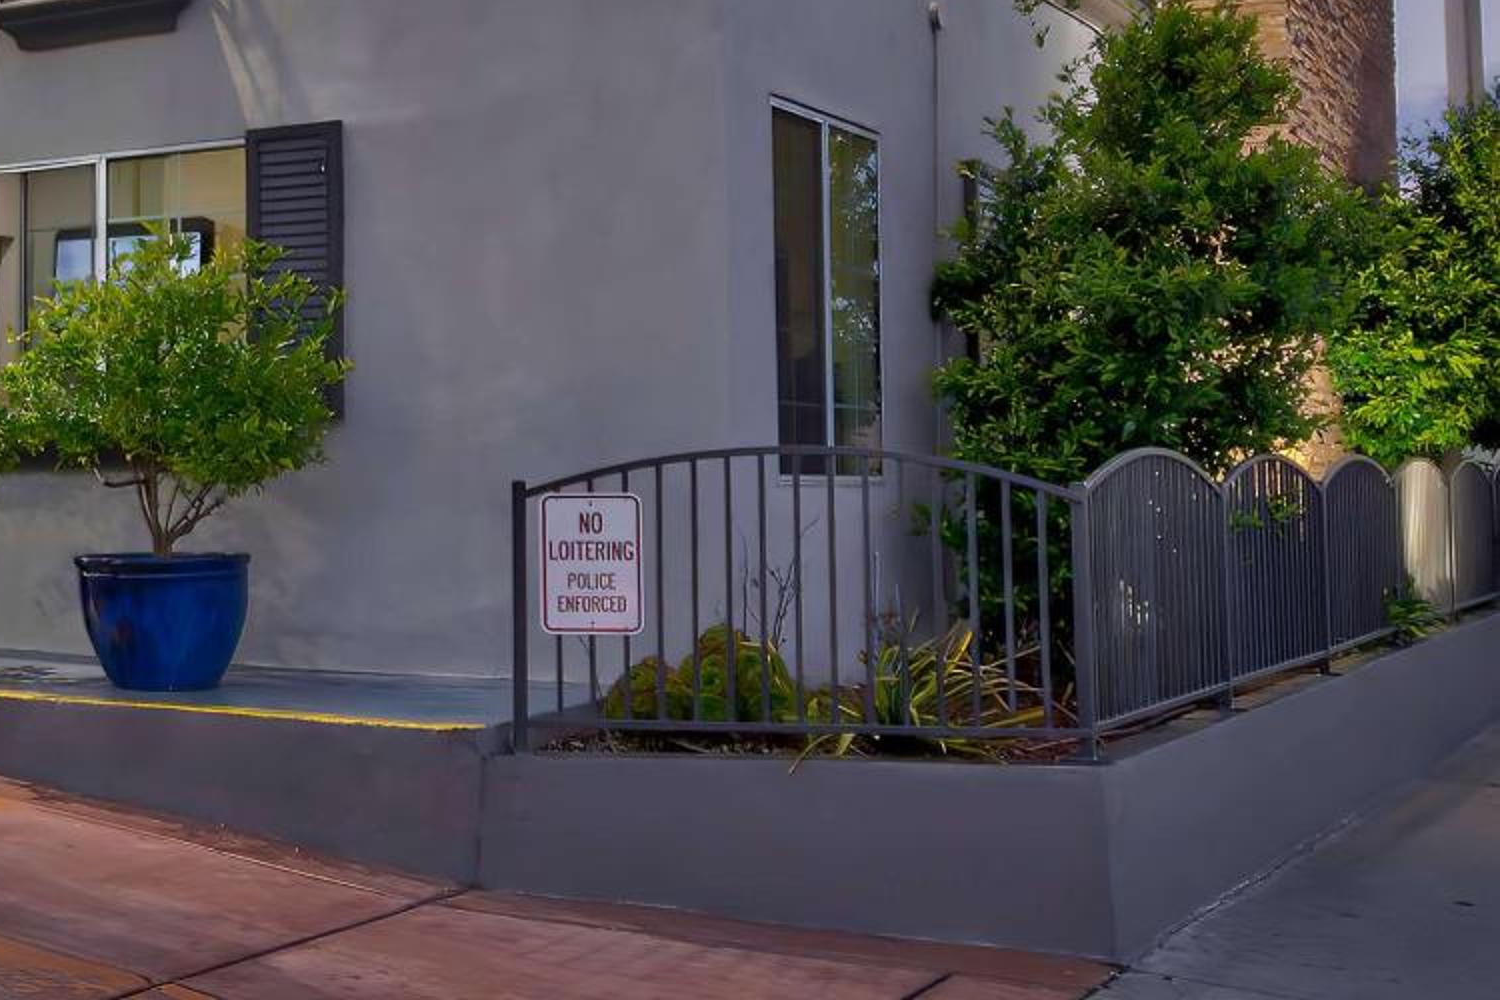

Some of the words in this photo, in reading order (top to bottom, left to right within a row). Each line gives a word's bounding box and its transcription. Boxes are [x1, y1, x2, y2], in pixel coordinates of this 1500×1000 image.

[579, 512, 603, 534] NO
[549, 540, 635, 561] LOITERING
[567, 572, 617, 591] POLICE
[557, 595, 627, 613] ENFORCED
